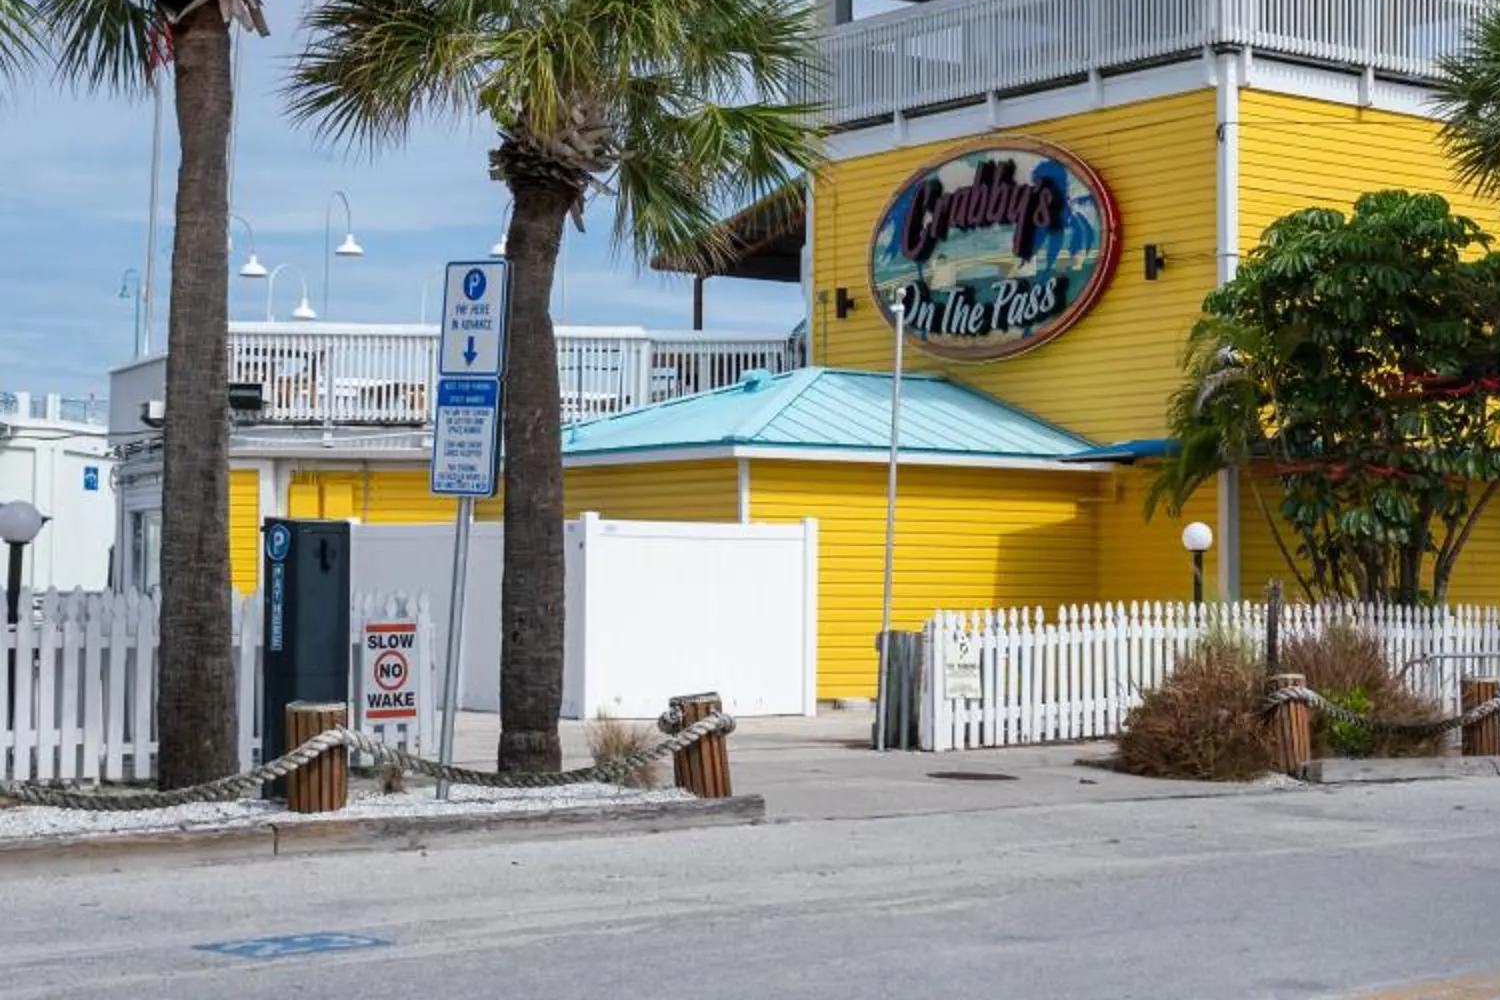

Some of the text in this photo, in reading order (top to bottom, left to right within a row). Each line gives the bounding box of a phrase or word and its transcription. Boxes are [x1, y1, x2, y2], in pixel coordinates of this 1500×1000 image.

[902, 160, 1057, 261] Crabby's
[939, 287, 984, 335] The
[991, 277, 1057, 330] Pass
[367, 634, 415, 649] SLOW
[379, 663, 403, 679] NO
[367, 692, 415, 708] WAKE
